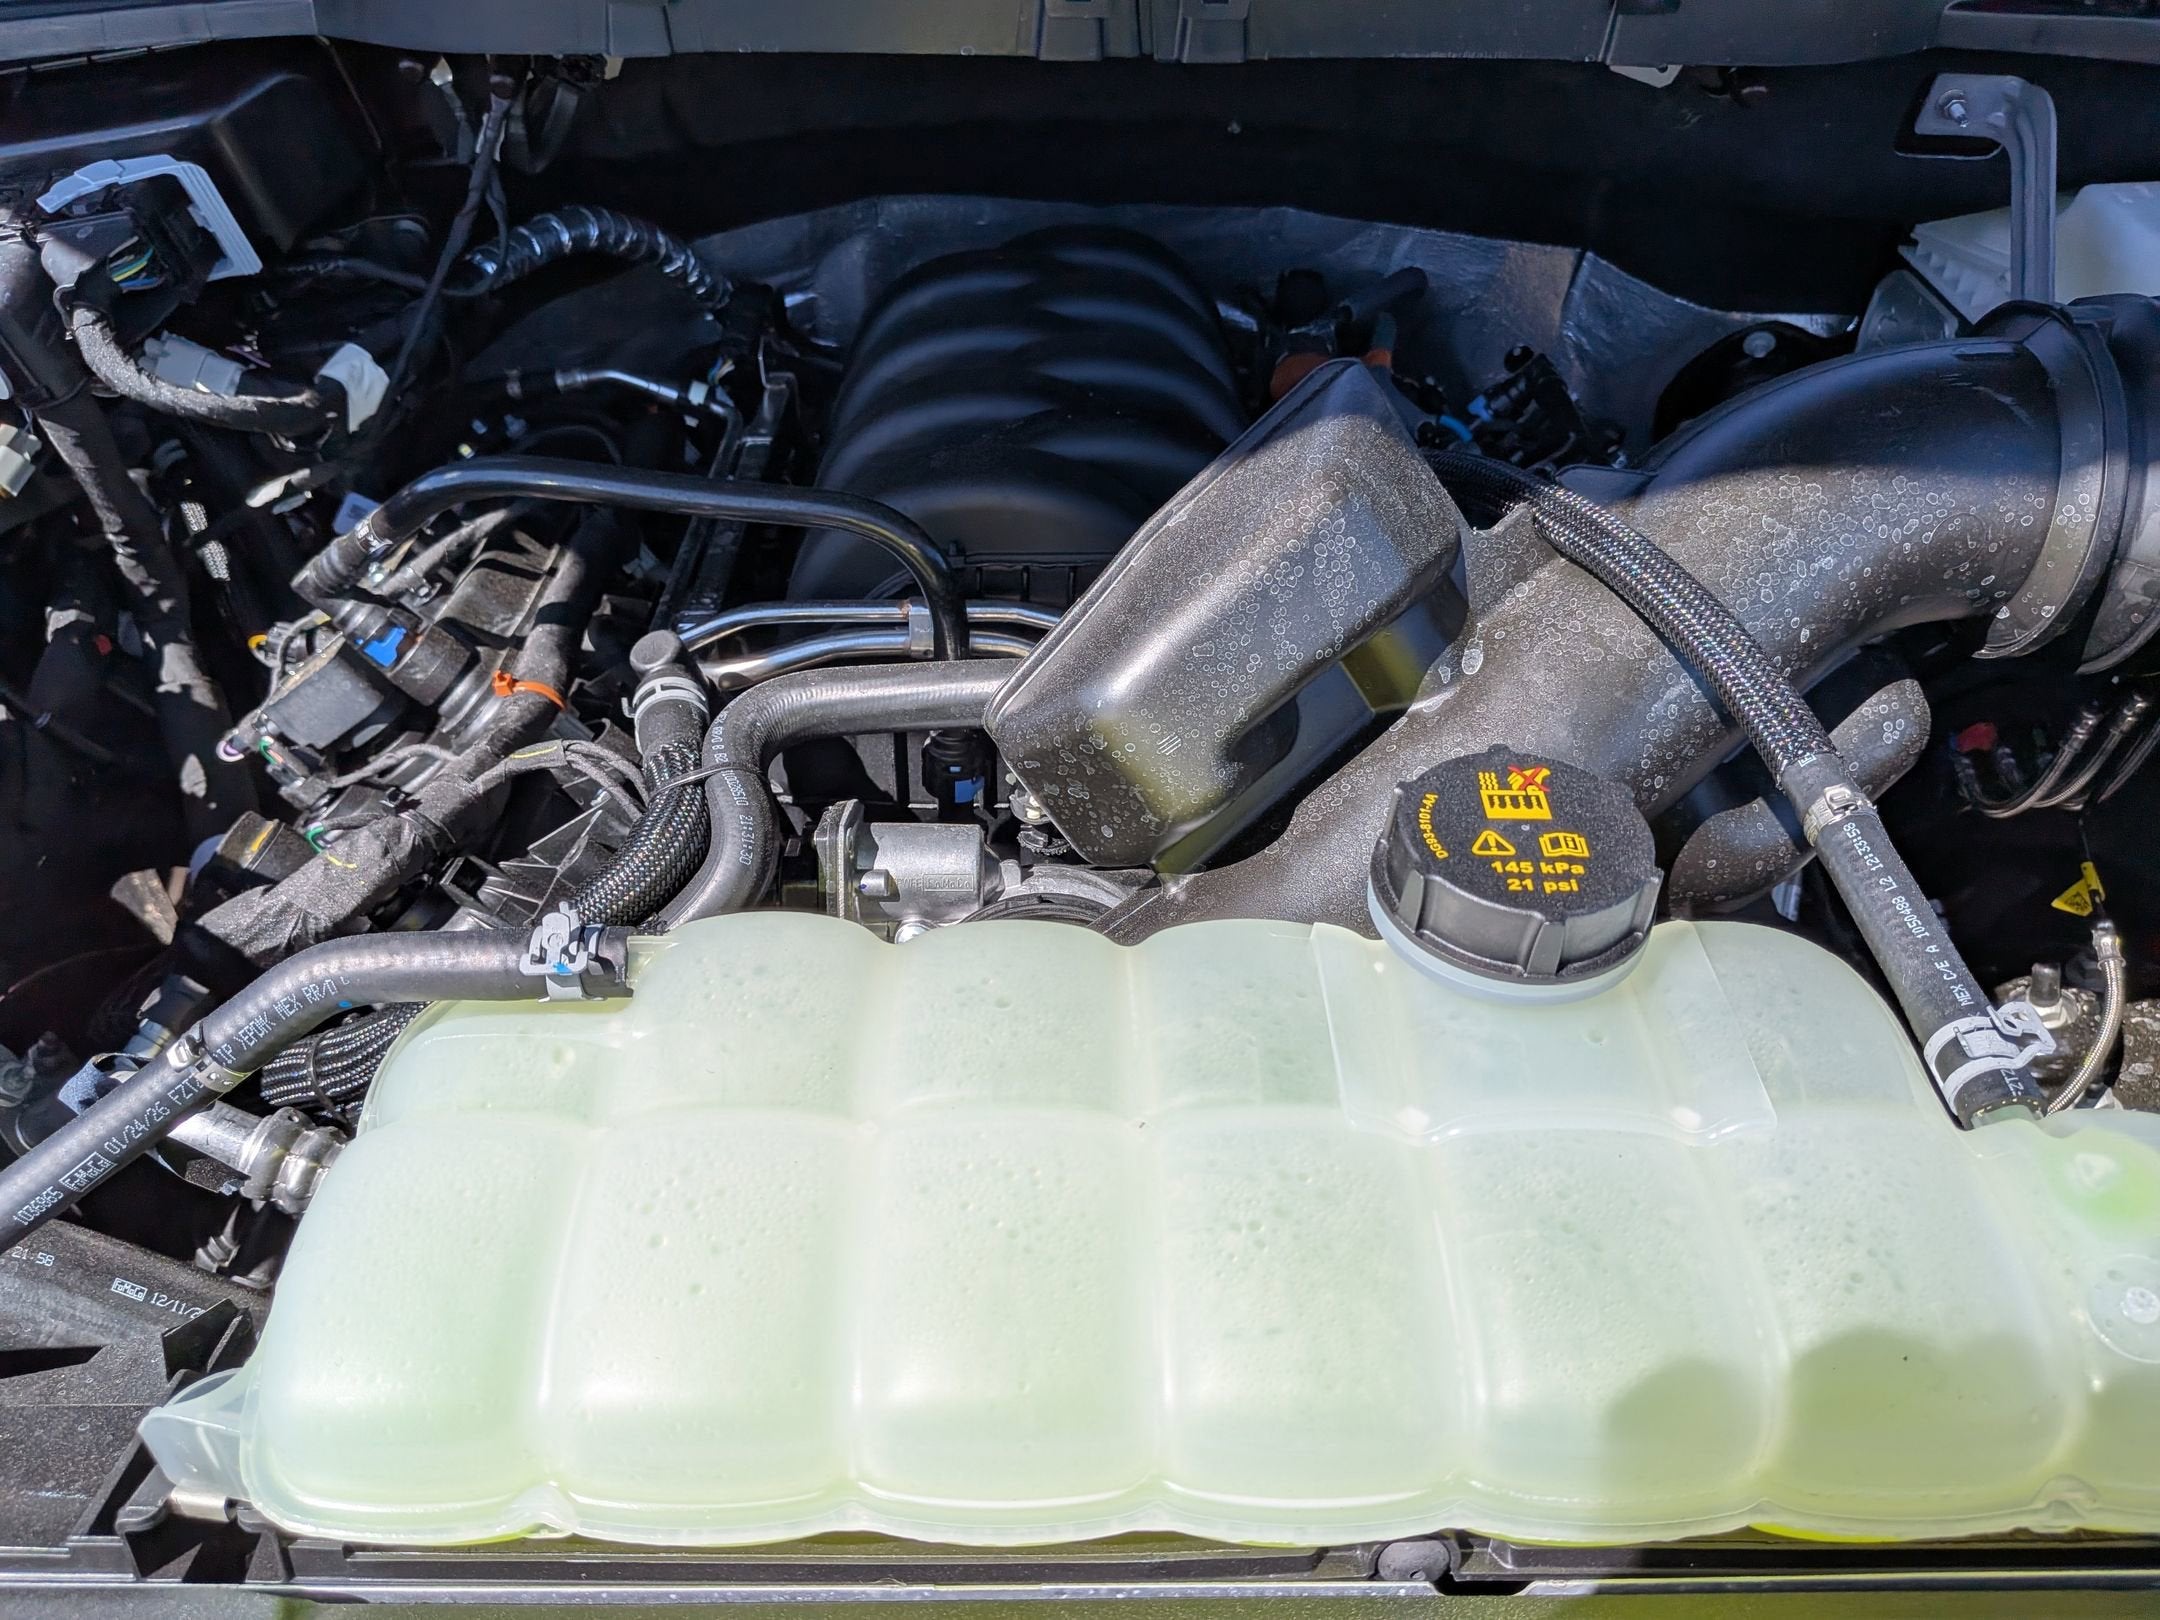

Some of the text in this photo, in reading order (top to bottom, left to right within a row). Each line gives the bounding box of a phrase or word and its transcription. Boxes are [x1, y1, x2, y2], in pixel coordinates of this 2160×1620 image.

[1418, 793, 1449, 860] DG93-8101-AA
[1843, 822, 1883, 871] 12:33:58
[1491, 861, 1585, 875] 145 kPa
[1507, 878, 1579, 894] 21 psi
[1879, 876, 1898, 892] L2
[1891, 895, 1930, 939] 1050488
[1925, 944, 1940, 953] A
[1950, 983, 1974, 1006] MEX
[104, 1101, 170, 1155] 01/24/26
[273, 993, 303, 1020] MEX
